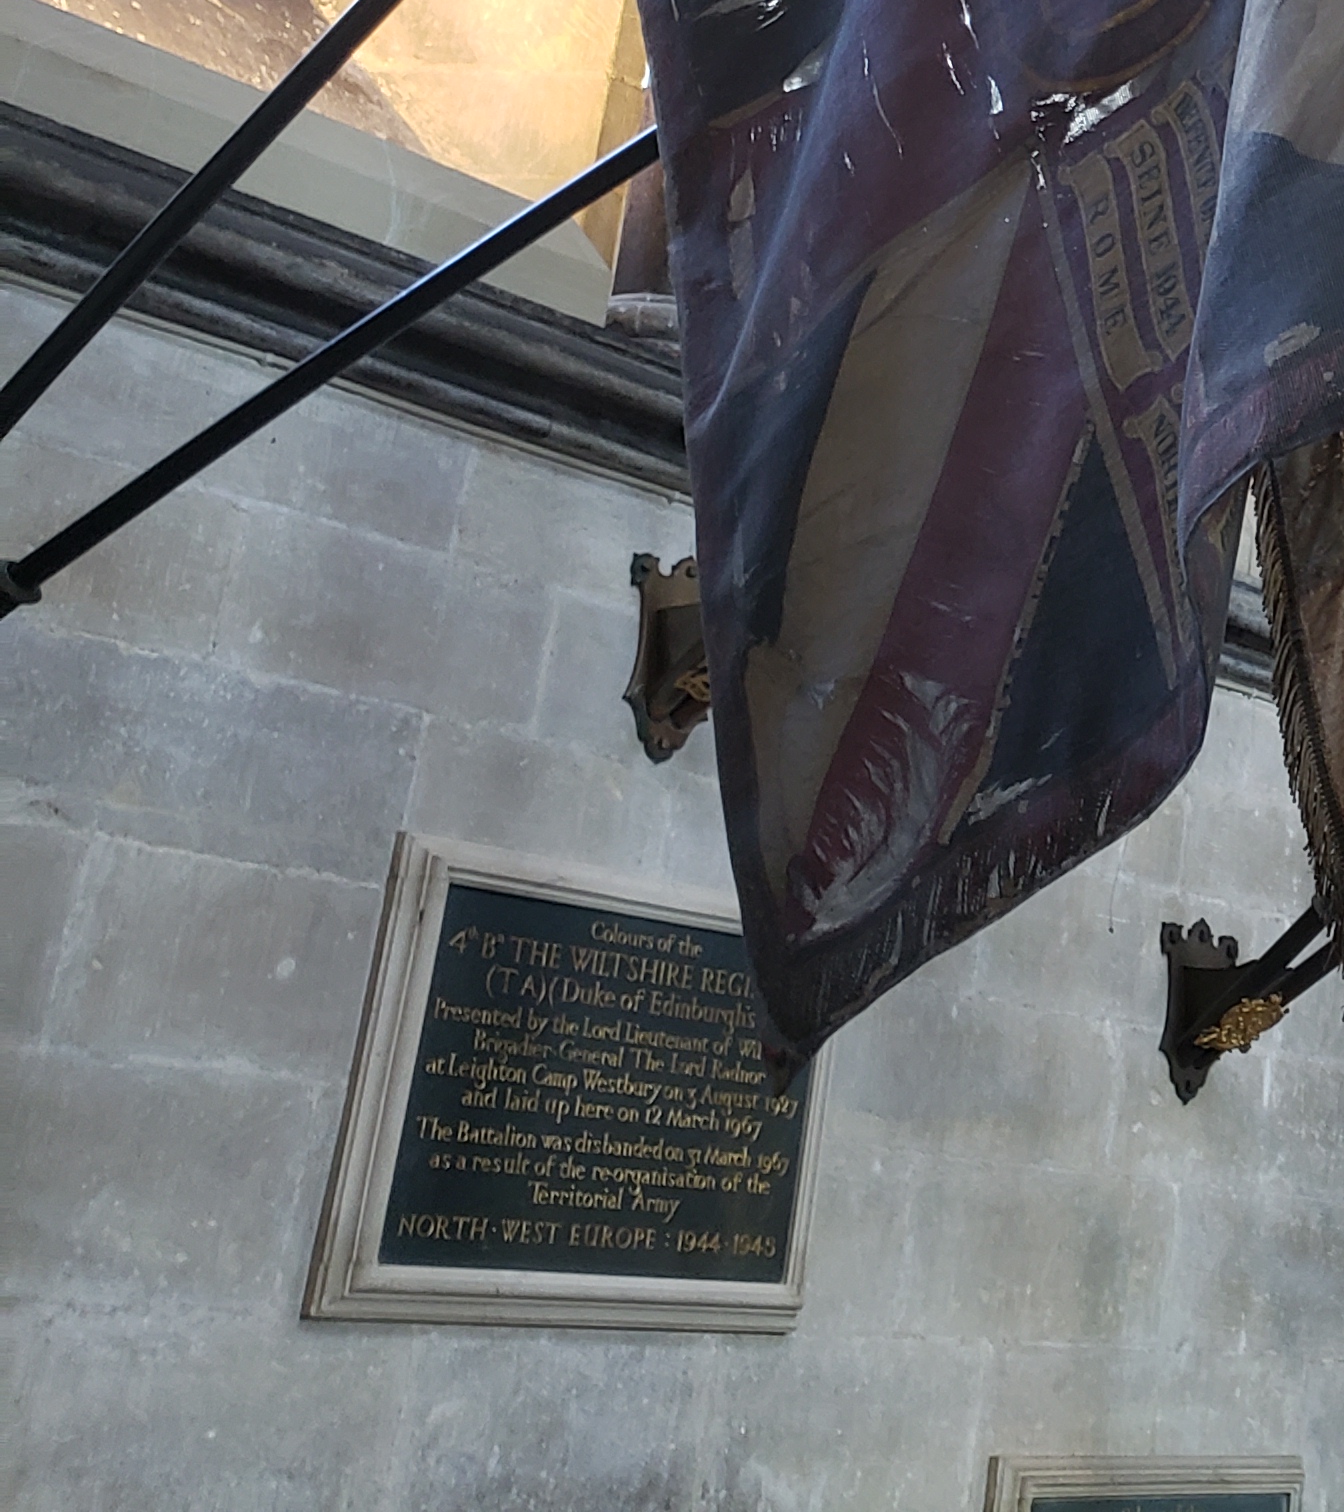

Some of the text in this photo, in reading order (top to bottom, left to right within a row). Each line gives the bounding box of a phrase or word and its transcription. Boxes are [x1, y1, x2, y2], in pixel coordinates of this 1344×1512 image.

[1088, 196, 1126, 338] ROME
[1132, 142, 1188, 338] SEINE 1944
[591, 920, 703, 957] Colours of the
[510, 936, 562, 968] THE
[570, 945, 694, 990] WILTSHIRE
[700, 968, 754, 999] REGI
[434, 997, 521, 1028] Presented
[528, 1006, 549, 1040] by
[553, 1012, 579, 1036] the
[584, 1016, 620, 1042] Lord
[625, 1021, 709, 1051] Lieutenant
[713, 1035, 733, 1057] of
[621, 989, 646, 1012] of
[425, 1057, 446, 1075] at
[449, 1052, 527, 1089] Leighton
[532, 1063, 578, 1096] Camp
[583, 1069, 662, 1105] Westbury
[664, 1085, 683, 1102] on
[701, 1083, 759, 1116] August
[630, 1048, 665, 1072] The
[671, 1053, 707, 1078] Lord
[711, 1058, 766, 1085] Radnor
[462, 1087, 763, 1142] and laid up here on 12 March 1967
[417, 1115, 453, 1141] The
[457, 1120, 537, 1149] Battalion
[542, 1134, 572, 1152] was
[574, 1129, 664, 1158] disbanded
[665, 1148, 684, 1162] on
[704, 1148, 752, 1169] March
[757, 1150, 791, 1177] 1967
[429, 1153, 452, 1169] as
[456, 1156, 467, 1170] a
[471, 1151, 530, 1175] result
[534, 1155, 556, 1177] of
[560, 1154, 586, 1180] the
[722, 1172, 743, 1193] of
[747, 1173, 771, 1195] the
[527, 1180, 681, 1224] Territorial Army
[568, 1222, 658, 1250] EUROPE
